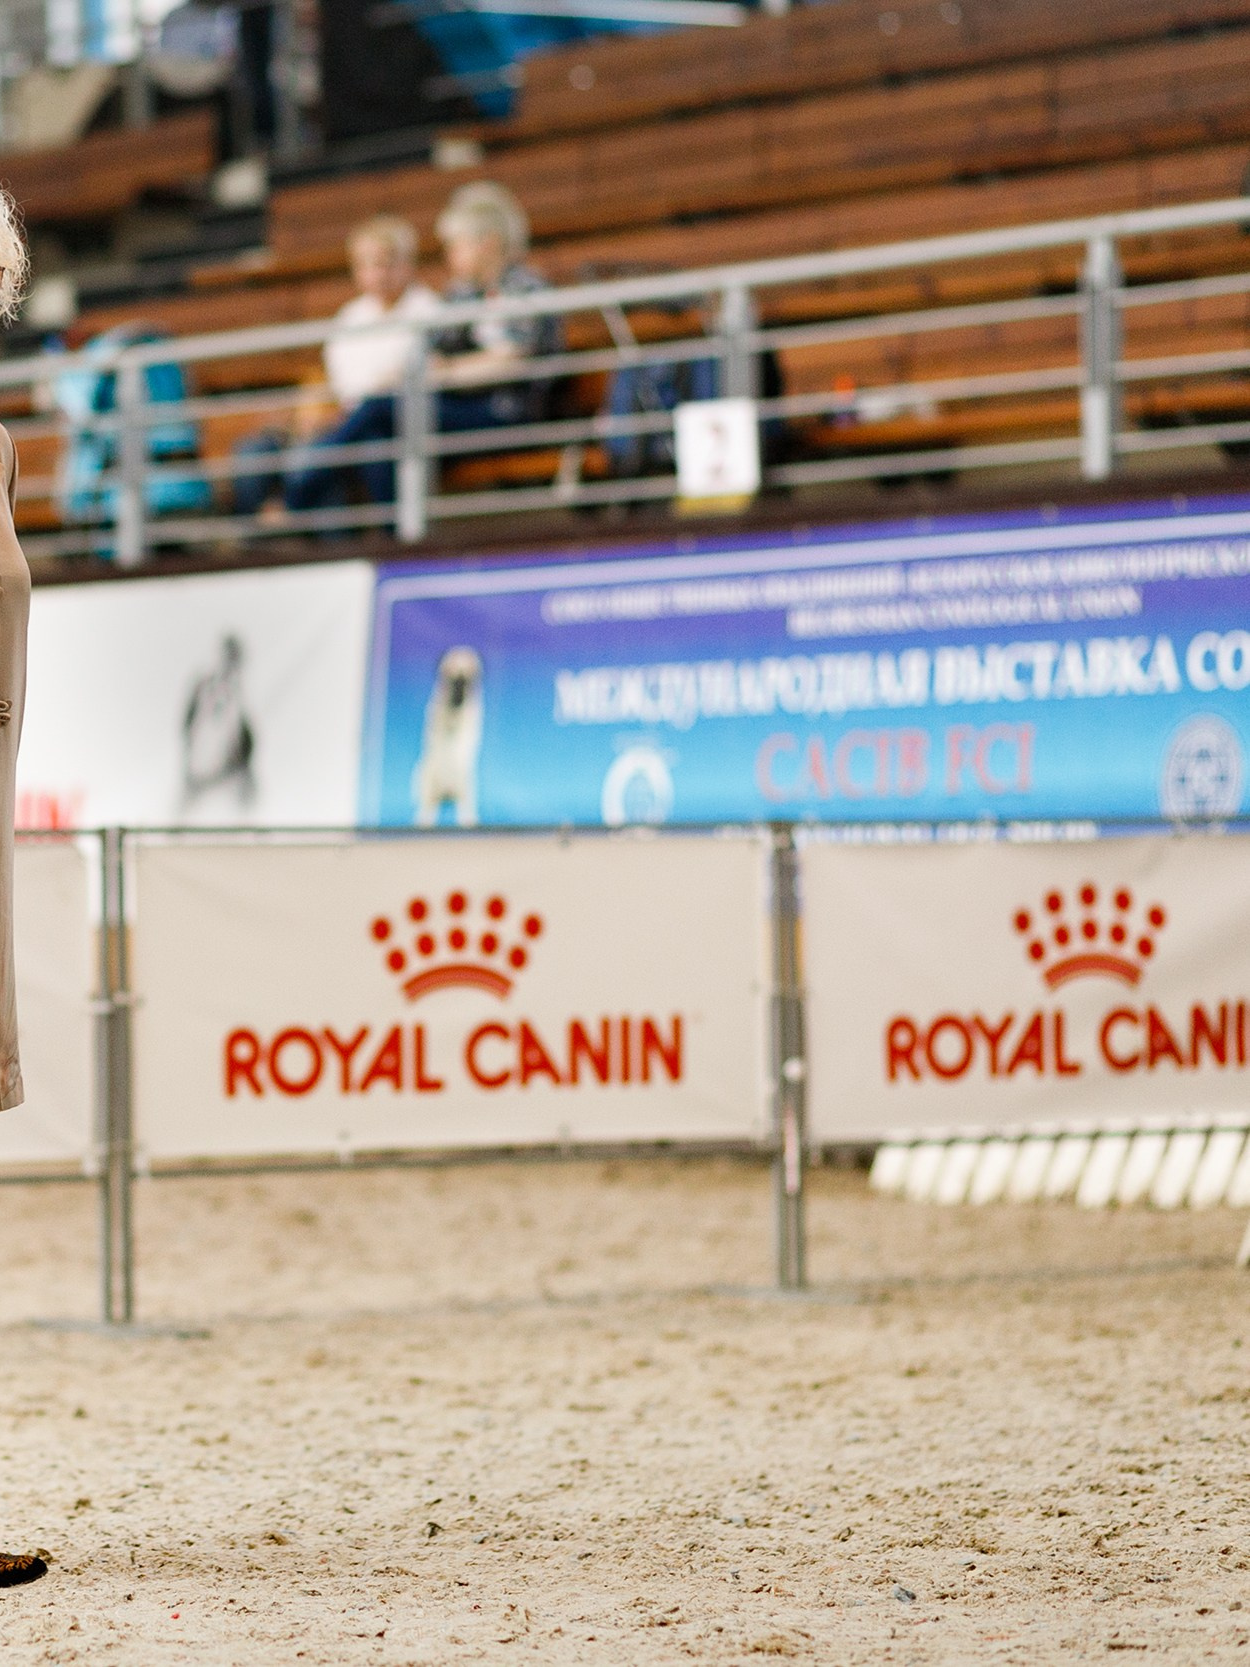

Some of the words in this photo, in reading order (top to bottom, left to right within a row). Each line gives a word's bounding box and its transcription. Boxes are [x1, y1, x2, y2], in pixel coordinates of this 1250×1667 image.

[934, 635, 1181, 705] ВЫСТАВКА
[756, 727, 931, 803] CACIB
[944, 719, 1035, 796] FCI
[223, 1024, 444, 1097] ROYAL
[463, 1015, 683, 1089] CANIN
[884, 1012, 1081, 1081] ROYAL
[1098, 1003, 1247, 1073] CANI
